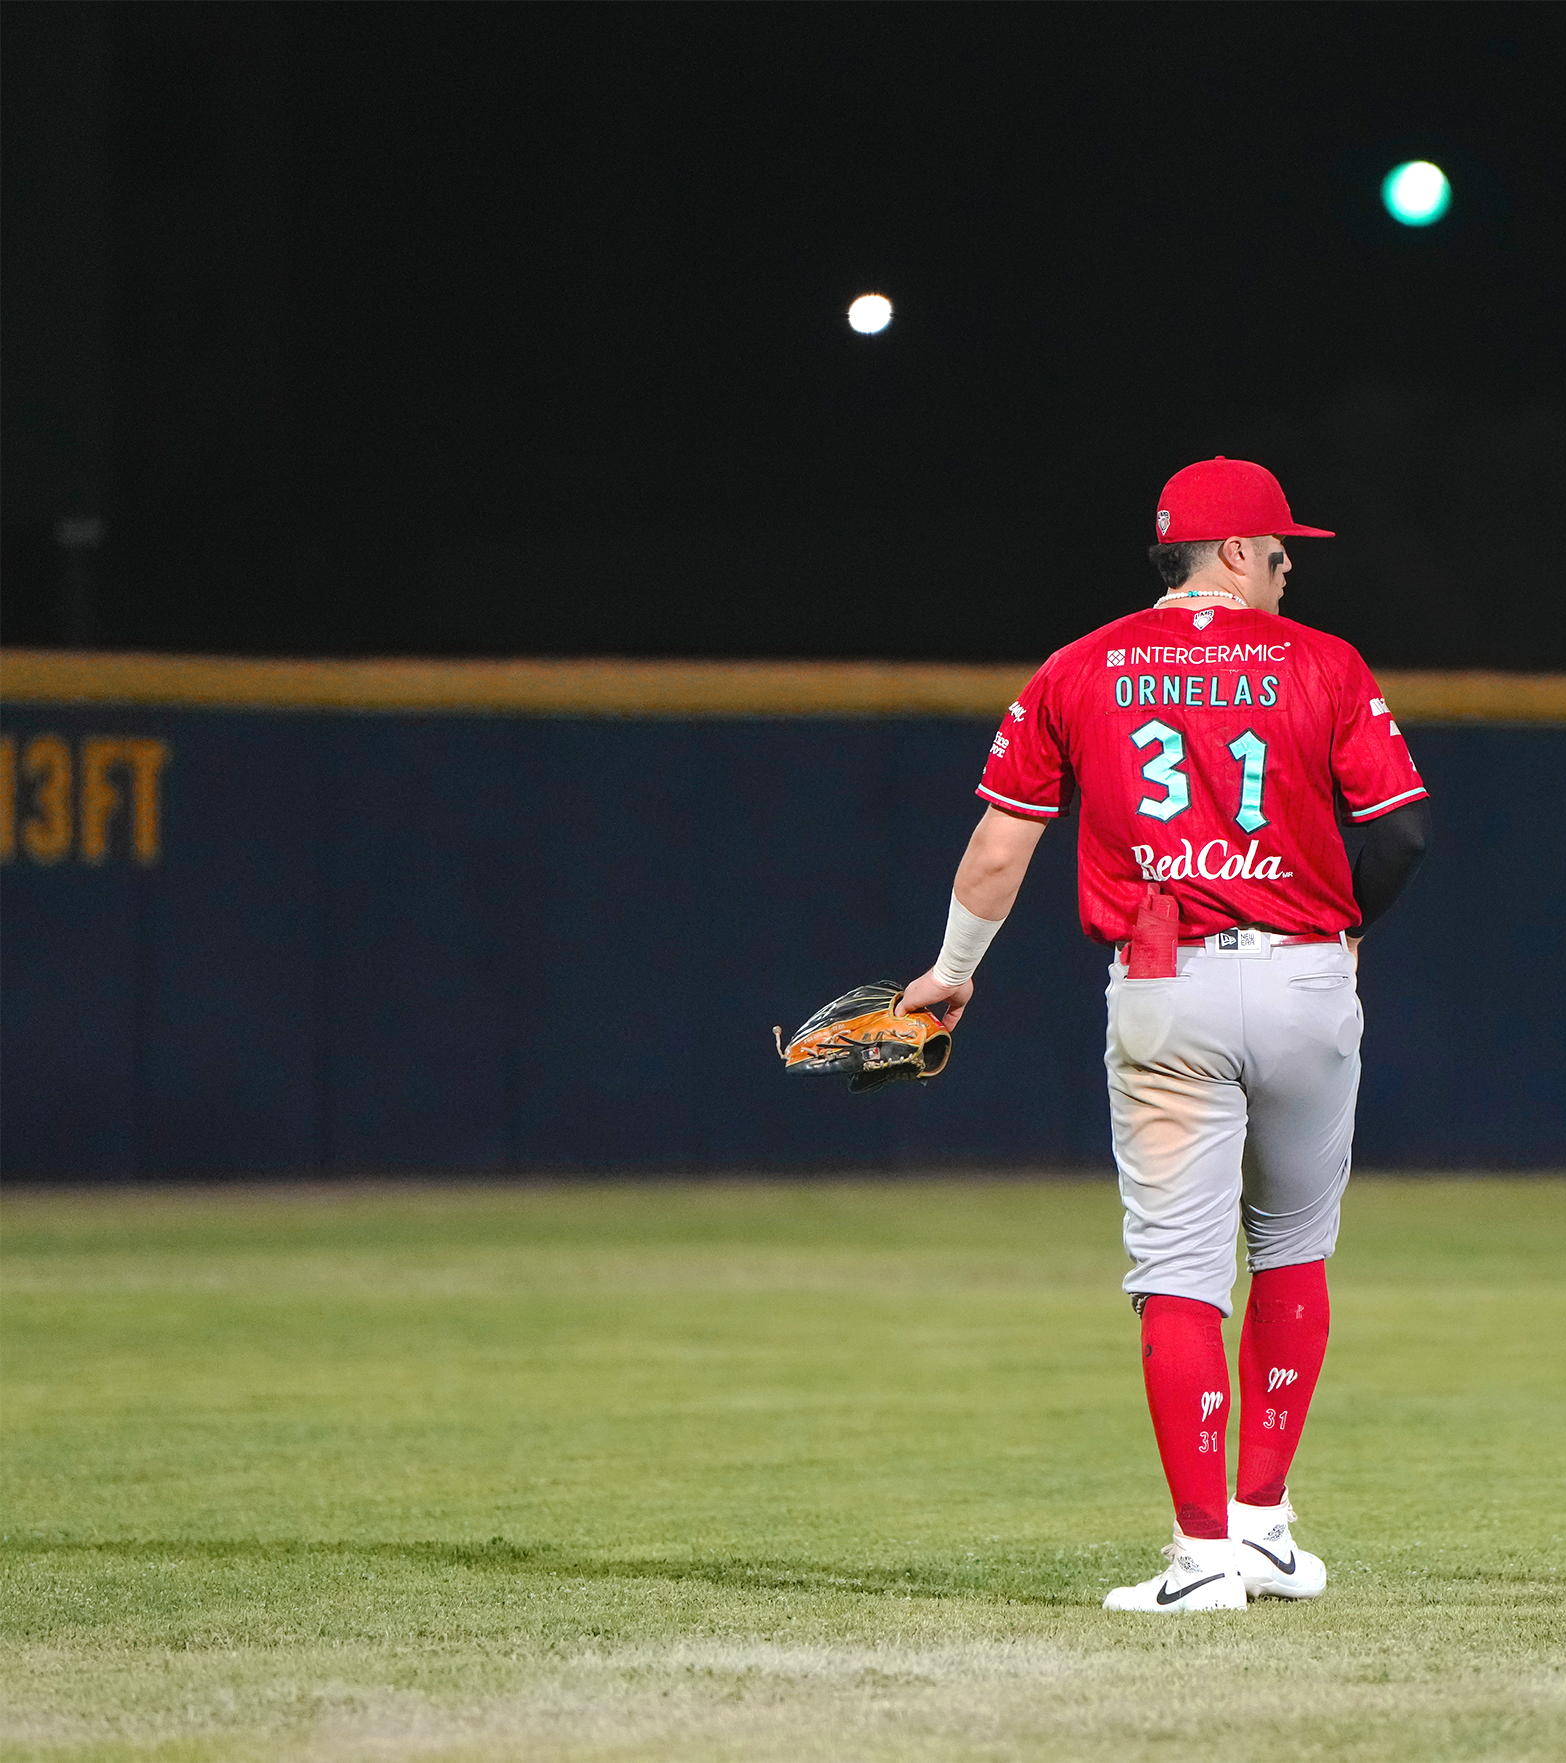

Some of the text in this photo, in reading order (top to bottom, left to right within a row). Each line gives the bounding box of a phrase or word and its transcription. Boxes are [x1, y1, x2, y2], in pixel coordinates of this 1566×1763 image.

[1115, 674, 1280, 708] ORNELAS
[1129, 717, 1271, 836] 31
[1262, 1408, 1288, 1430] 31
[1198, 1431, 1218, 1453] 31
